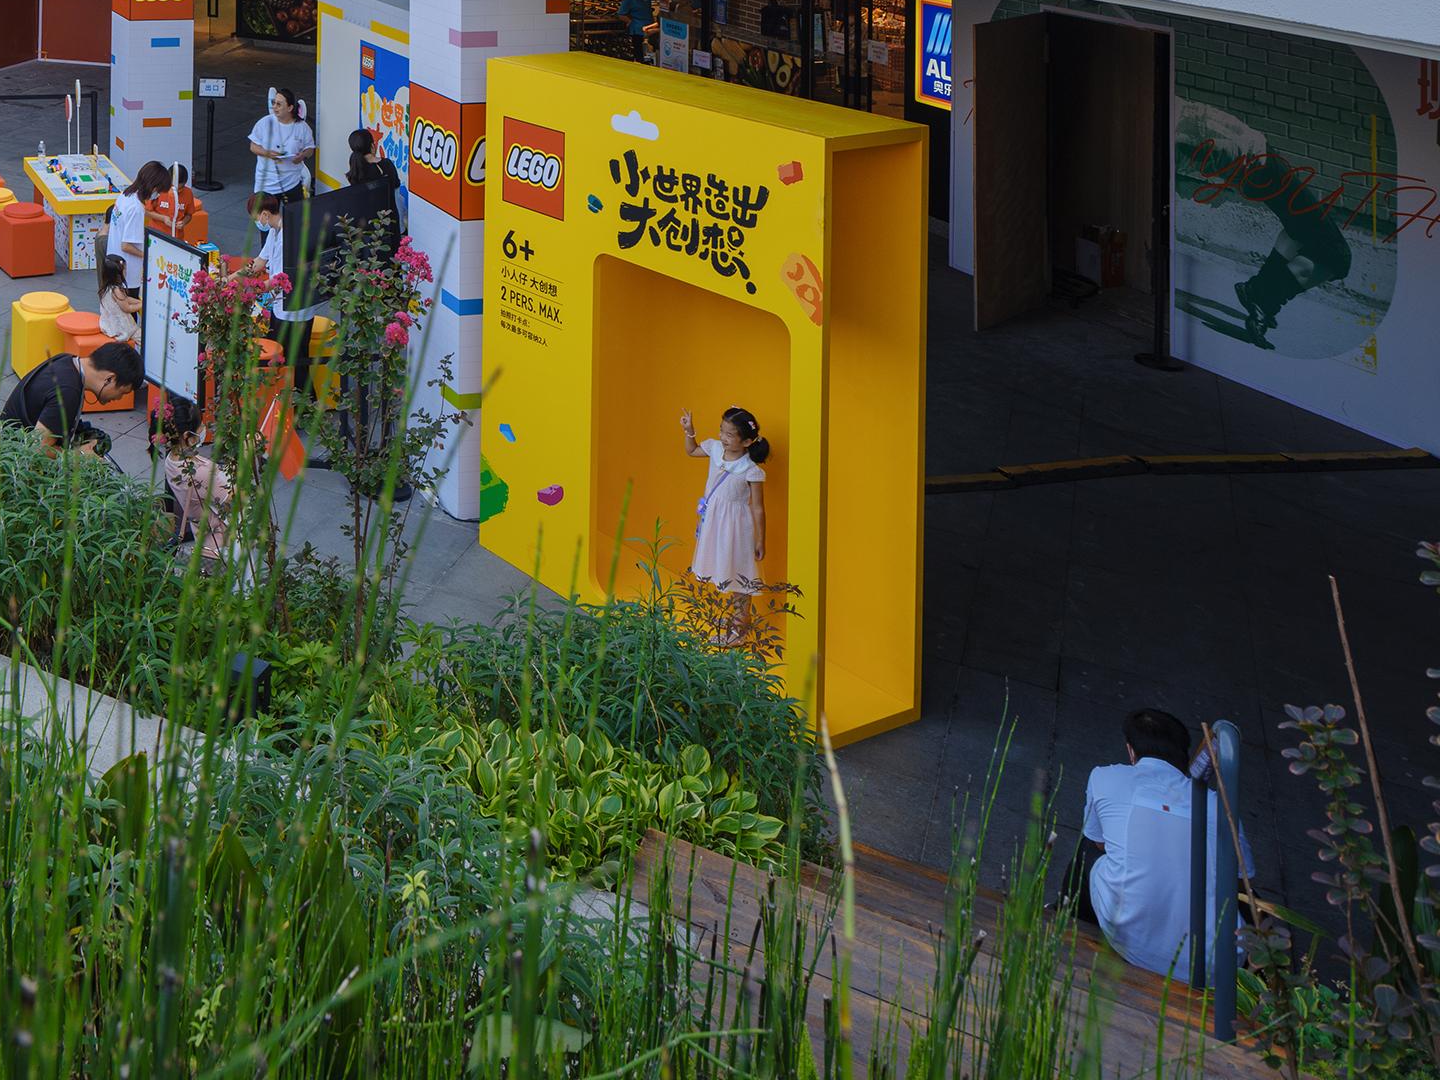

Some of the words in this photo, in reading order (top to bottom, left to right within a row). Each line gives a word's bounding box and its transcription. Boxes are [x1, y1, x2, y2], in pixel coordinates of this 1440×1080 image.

[361, 84, 409, 137] 小世界
[411, 118, 458, 179] LEGO
[505, 143, 562, 191] LEGO
[609, 149, 770, 228] 小世界造出
[502, 229, 535, 261] 6+
[500, 286, 507, 301] 2
[509, 290, 536, 313] PERS.
[539, 302, 563, 324] MAX.
[501, 266, 528, 286] 小人仔
[530, 277, 558, 297] 大创想
